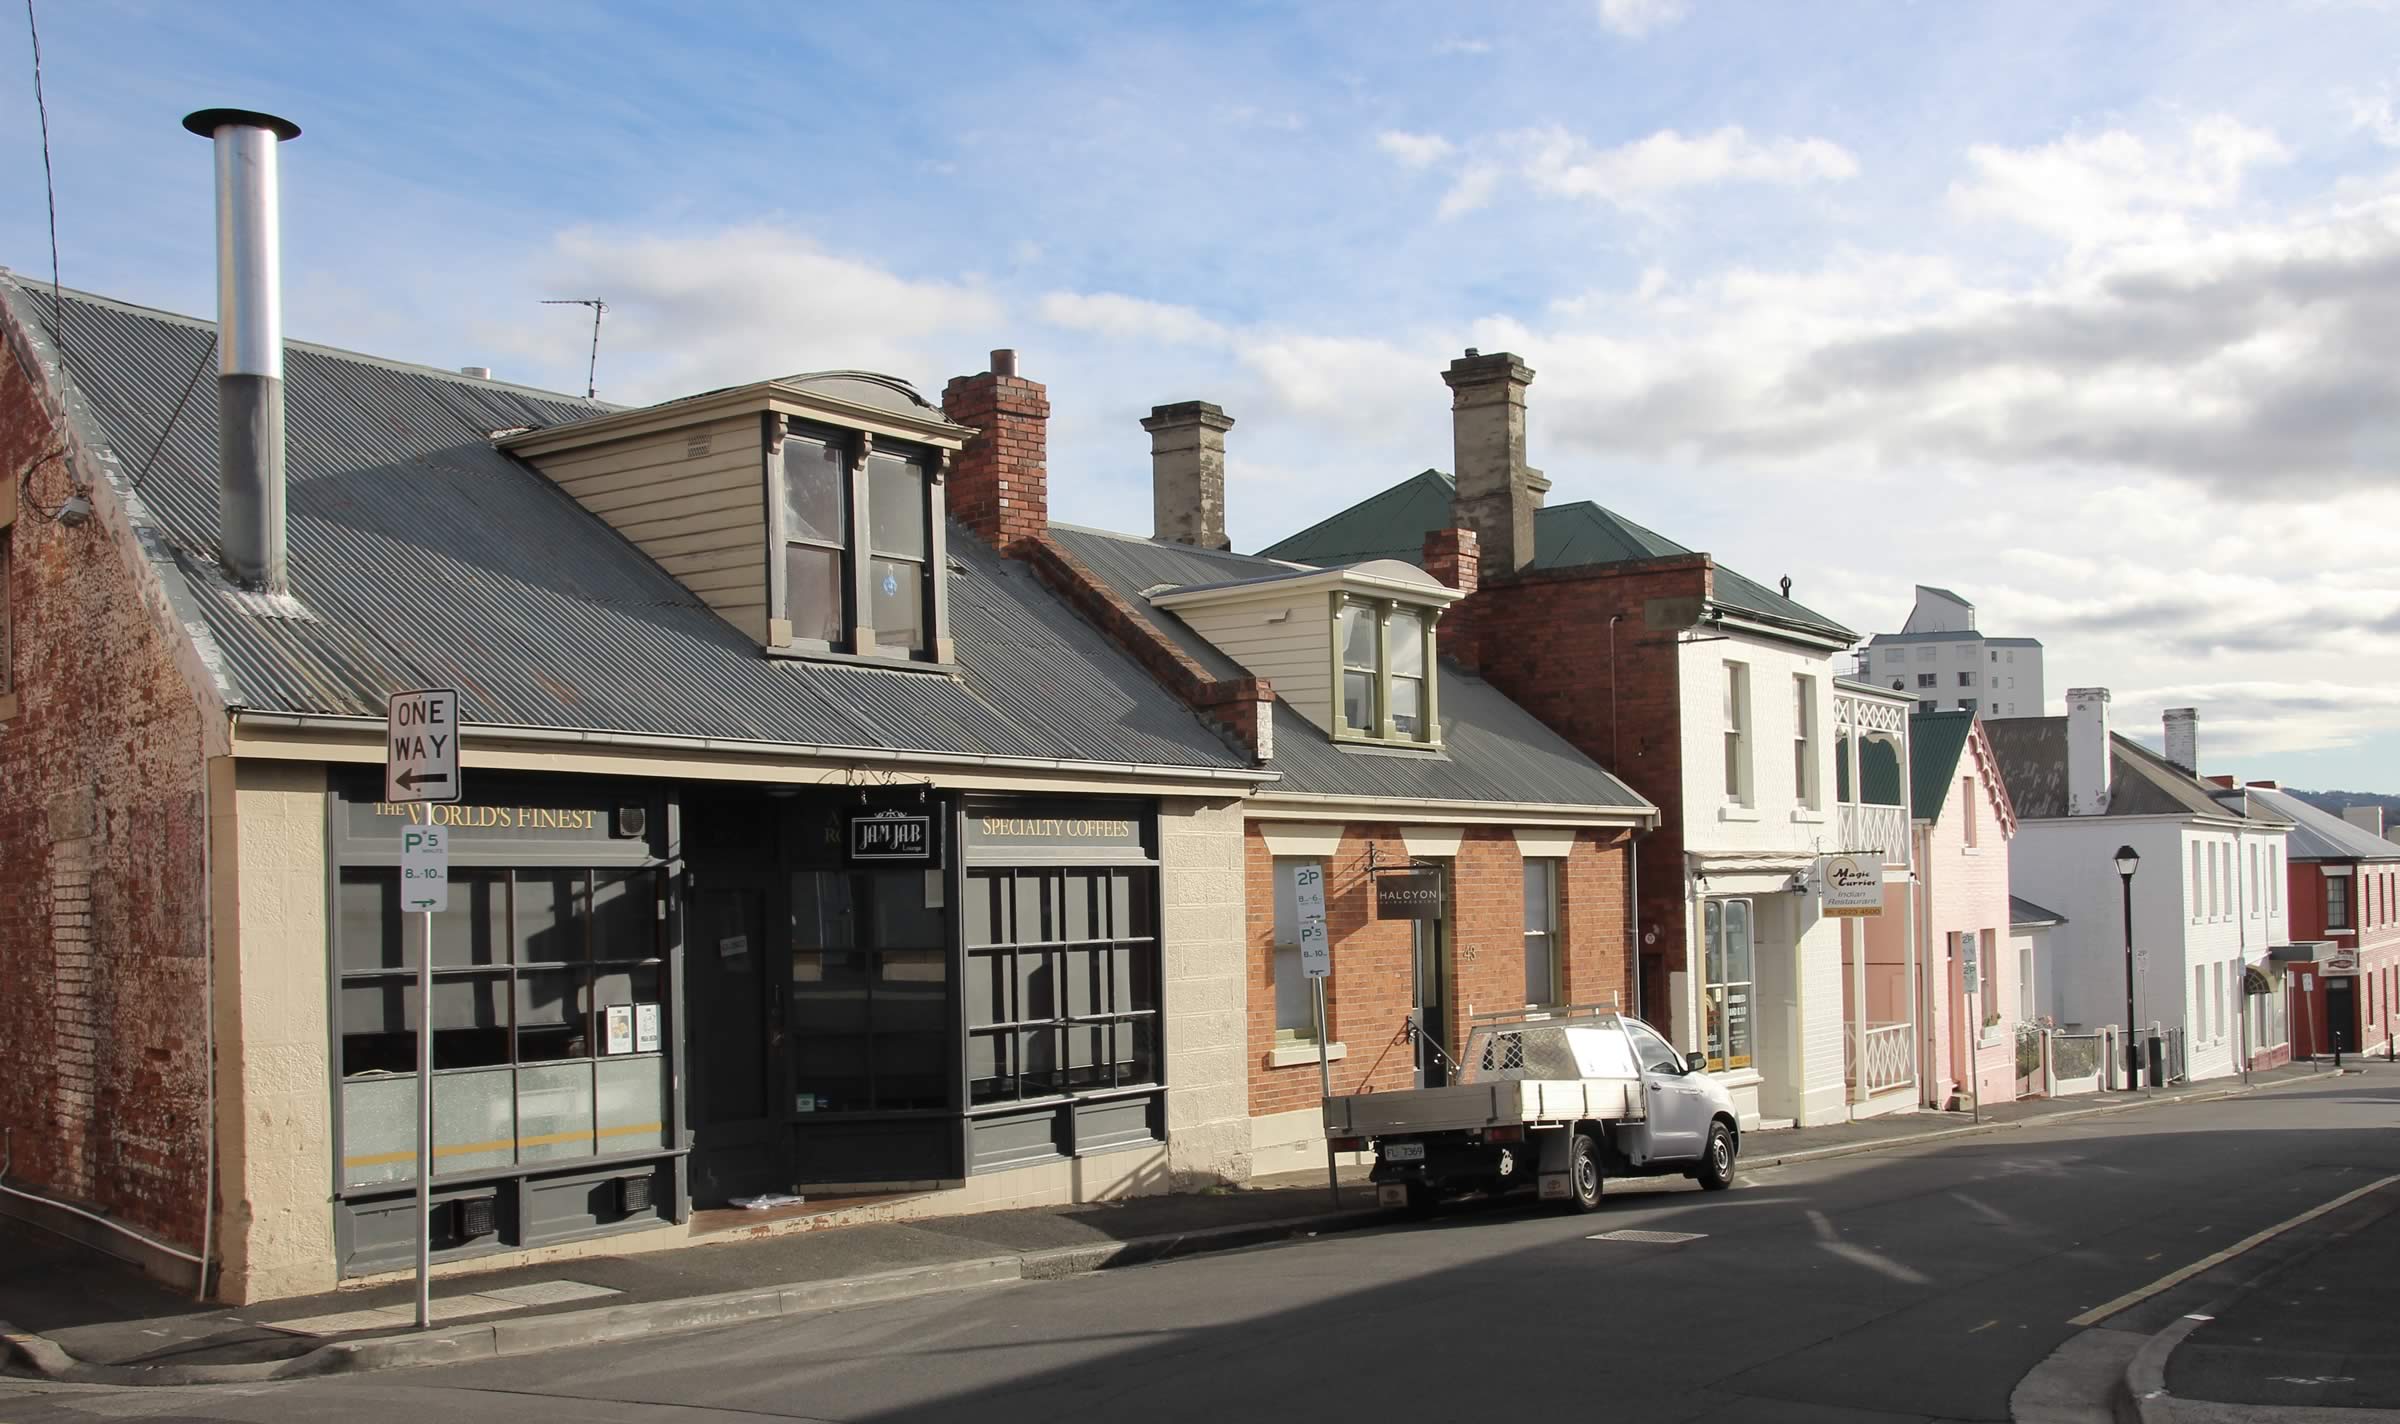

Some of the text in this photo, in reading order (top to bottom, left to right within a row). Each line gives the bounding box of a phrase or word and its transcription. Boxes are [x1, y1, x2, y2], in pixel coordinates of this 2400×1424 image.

[398, 700, 444, 726] ONE
[395, 734, 449, 761] WAY
[373, 802, 405, 816] THE
[518, 808, 597, 829] FINEST
[859, 824, 890, 850] JAM
[982, 816, 1129, 837] SPECIALTY COFFEES
[1297, 871, 1320, 885] 2P
[1832, 868, 1870, 879] Magic
[1838, 877, 1877, 887] Curries
[1380, 890, 1437, 900] HALCYON
